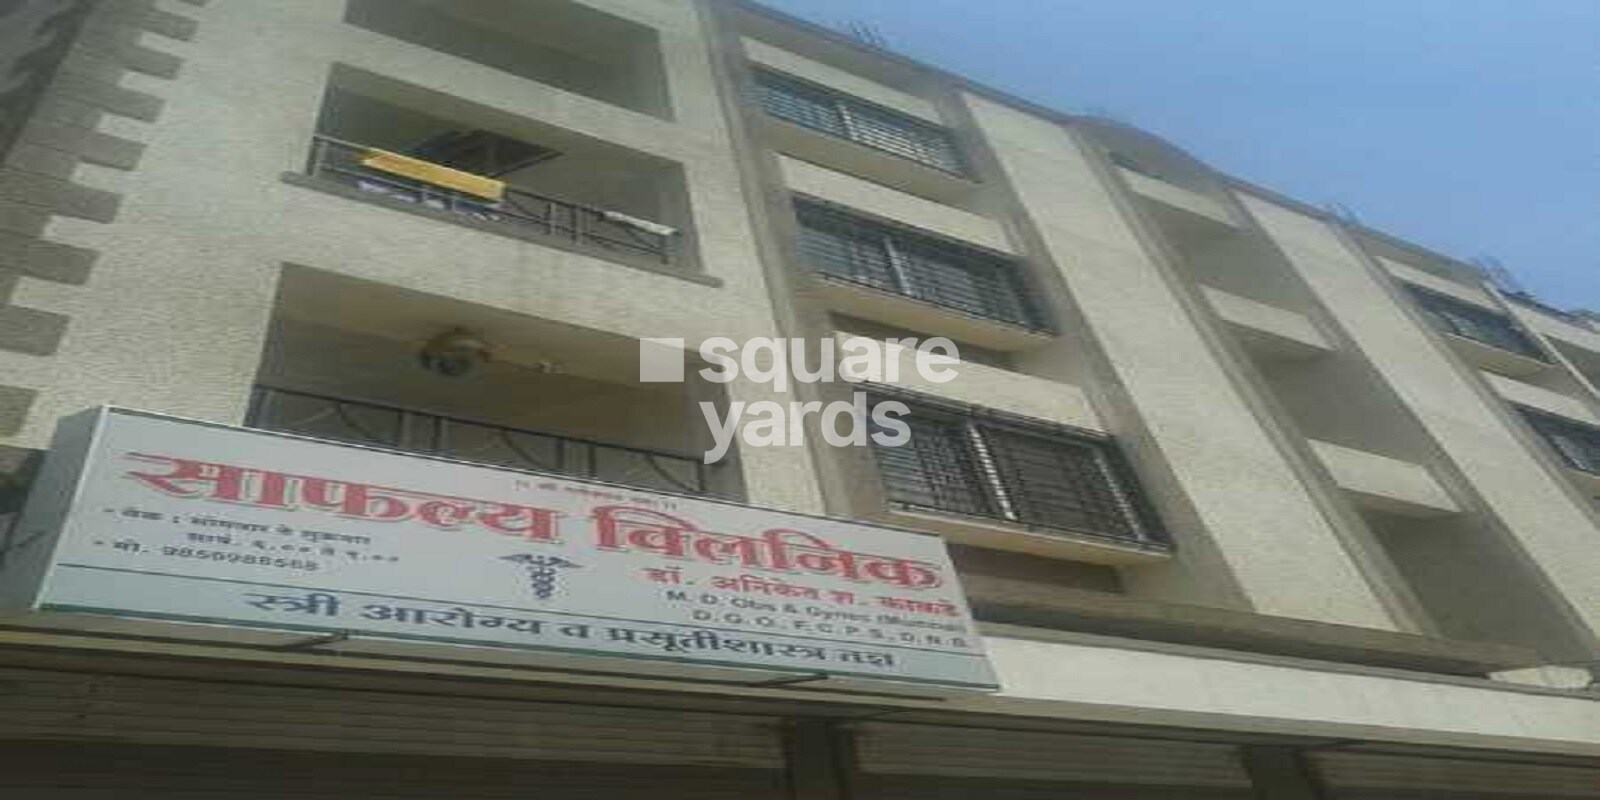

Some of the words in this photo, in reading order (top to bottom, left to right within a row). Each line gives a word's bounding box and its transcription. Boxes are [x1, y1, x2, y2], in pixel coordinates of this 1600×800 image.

[123, 452, 561, 543] साफल्य
[592, 505, 943, 588] क्लिनिक
[243, 592, 339, 617] स्त्री
[359, 602, 542, 635] आरोग्य
